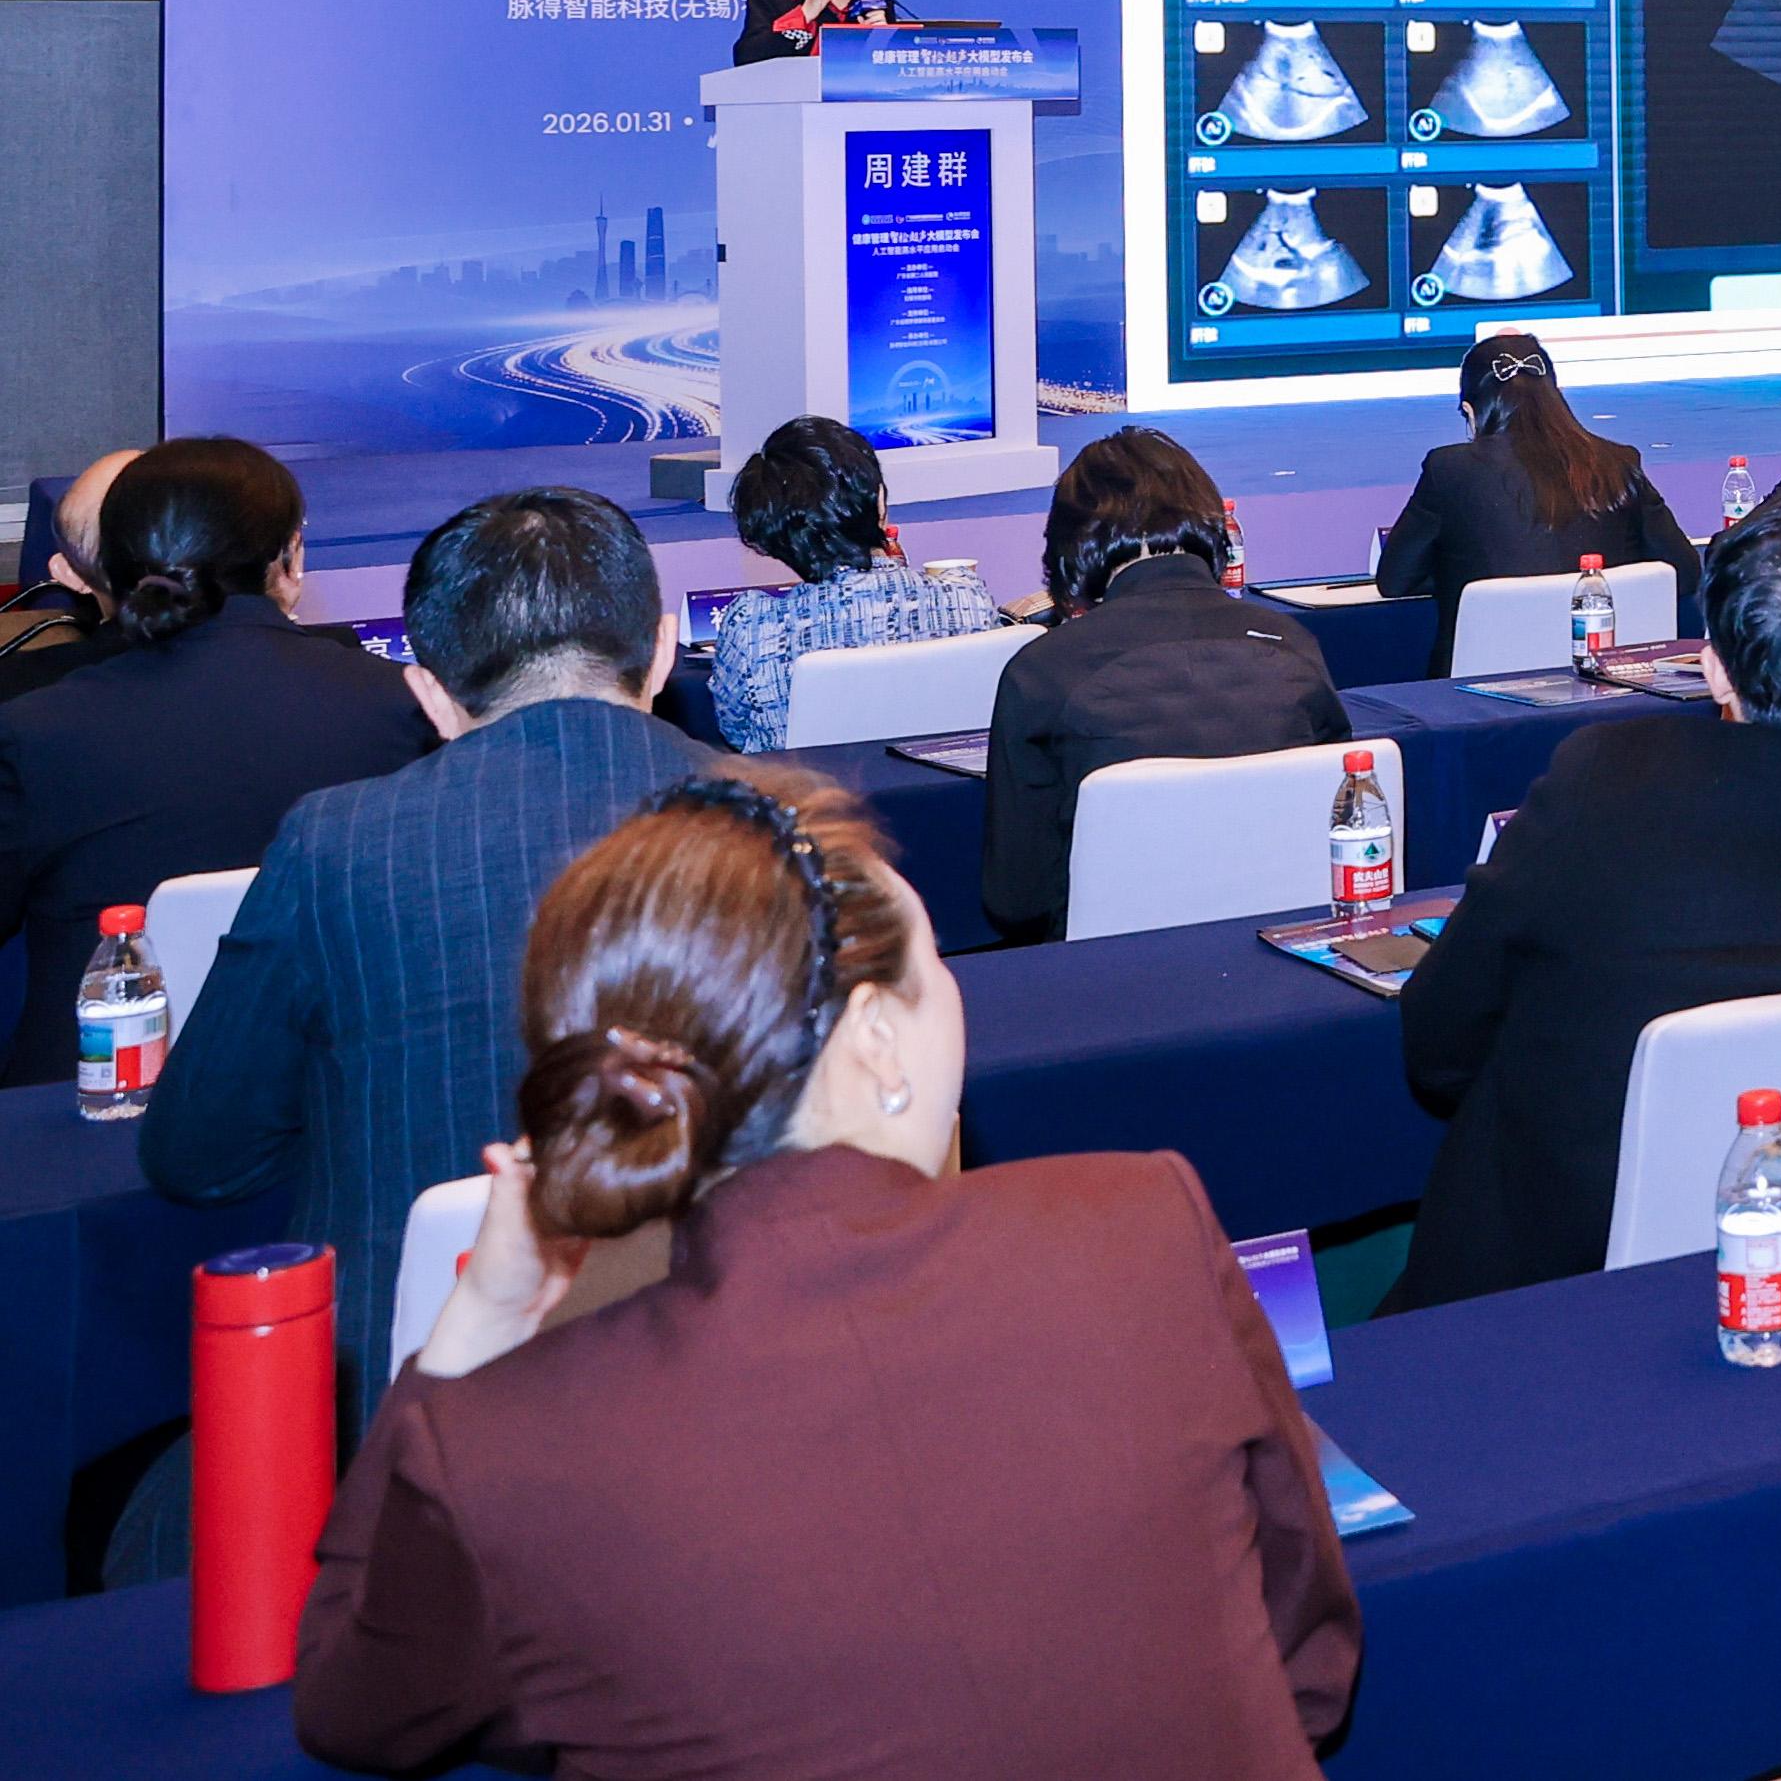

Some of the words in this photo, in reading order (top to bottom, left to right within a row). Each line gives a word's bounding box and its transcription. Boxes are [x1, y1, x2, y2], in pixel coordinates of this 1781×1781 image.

[542, 110, 670, 135] 2026.01.31
[864, 151, 967, 189] 周建群
